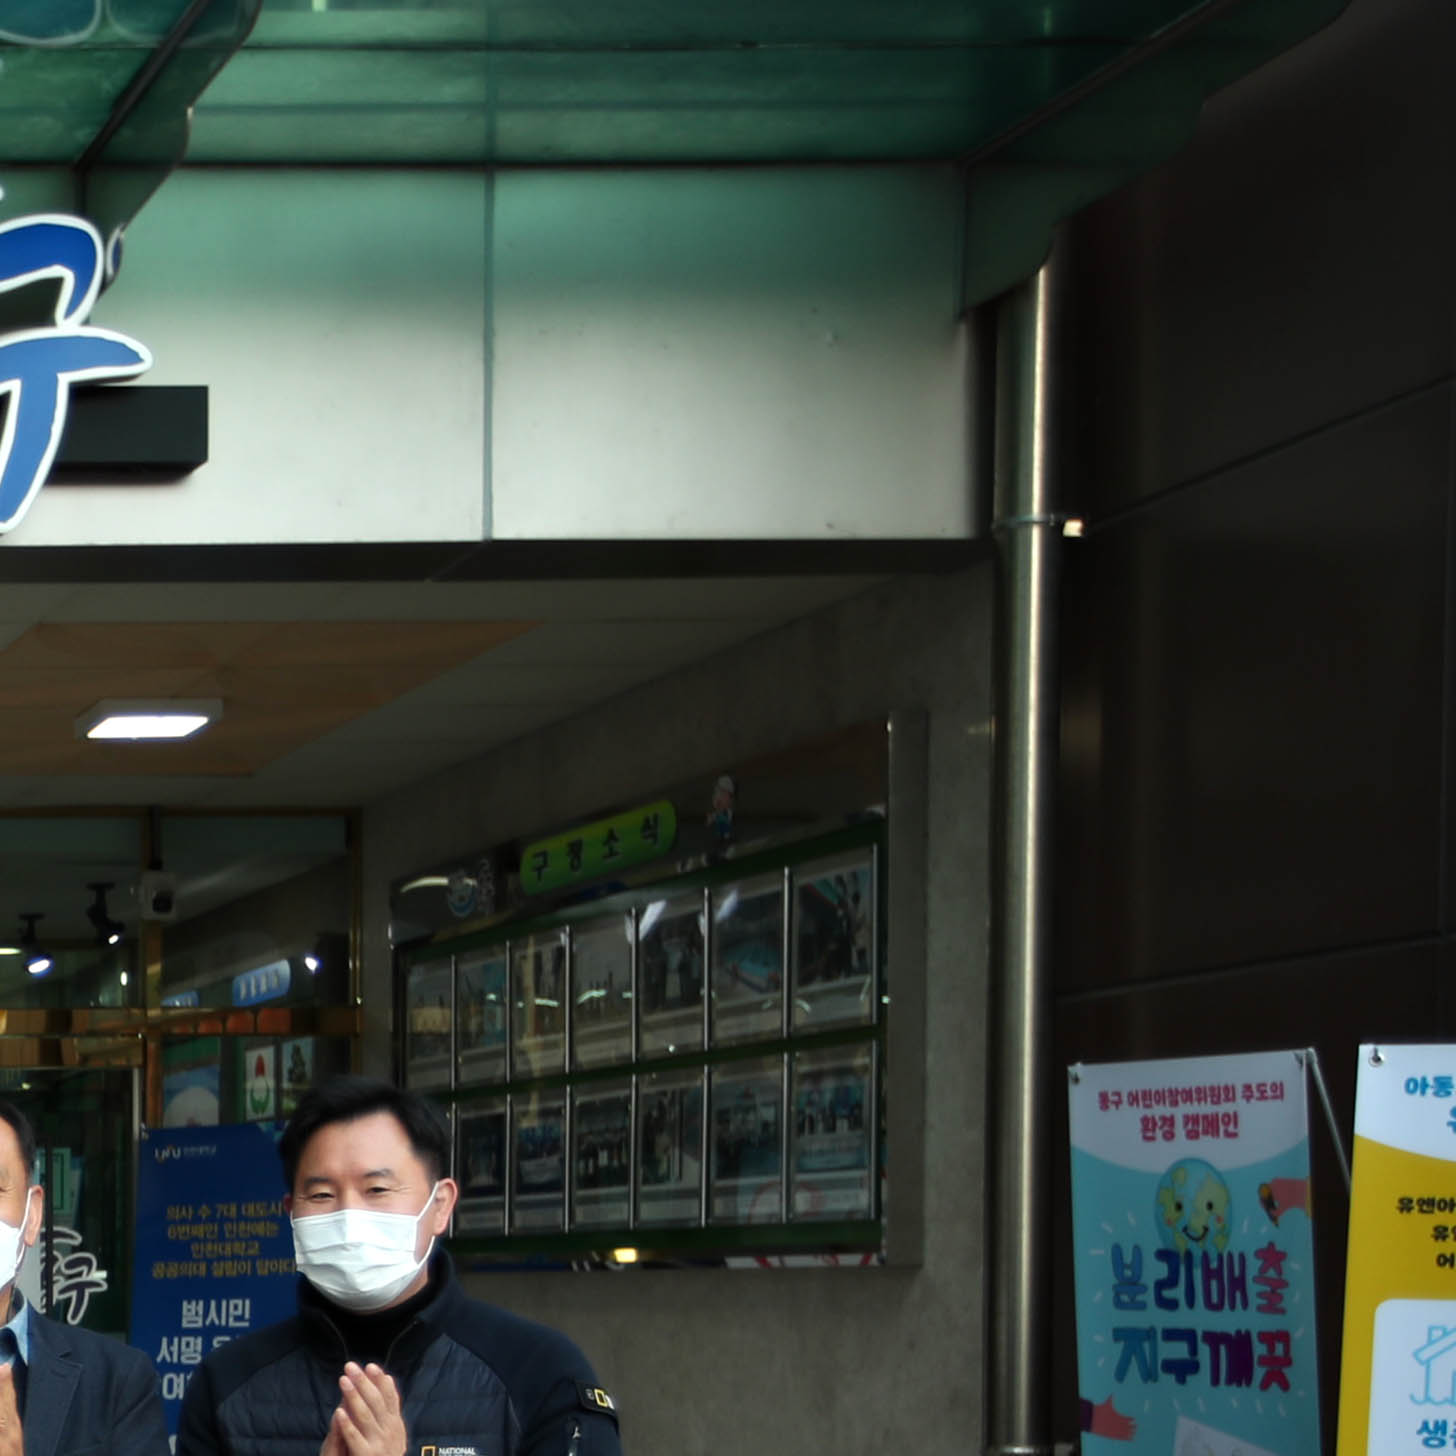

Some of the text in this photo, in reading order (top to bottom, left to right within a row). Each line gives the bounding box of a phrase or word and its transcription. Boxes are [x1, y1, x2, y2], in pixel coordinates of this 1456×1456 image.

[1098, 1089, 1123, 1111] 동구
[1241, 1081, 1285, 1103] 주도의
[1404, 1075, 1456, 1098] 아동
[1140, 1112, 1239, 1142] 환경 캠페인
[1111, 1241, 1289, 1315] 분리배출
[181, 1298, 251, 1329] 범시민
[156, 1336, 203, 1364] 서명
[438, 1447, 476, 1456] NATIONAL
